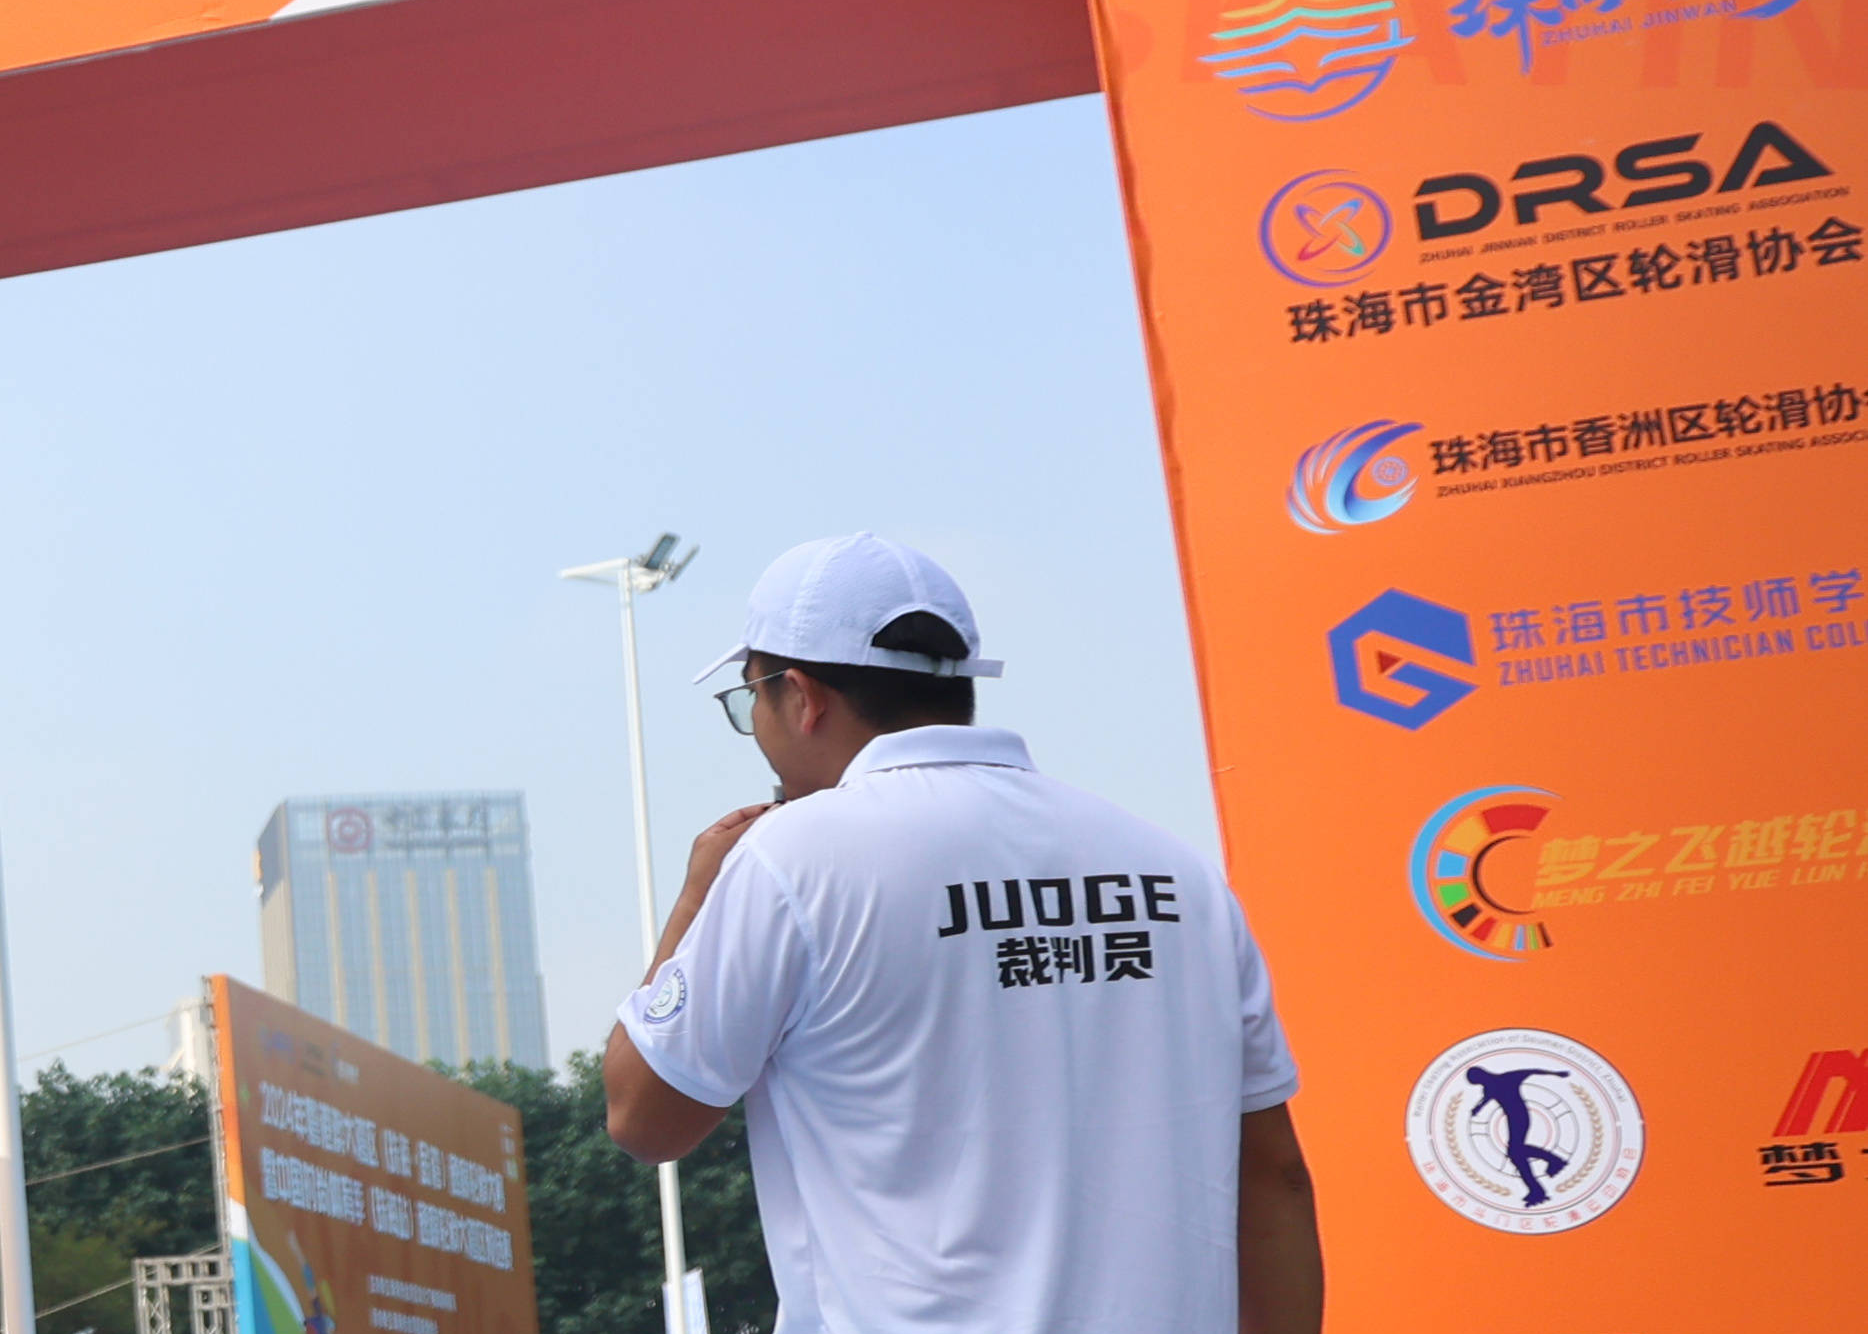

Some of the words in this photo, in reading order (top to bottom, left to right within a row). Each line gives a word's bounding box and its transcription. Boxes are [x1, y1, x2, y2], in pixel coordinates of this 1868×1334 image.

[1539, 17, 1633, 47] ZHUHAI
[1413, 120, 1836, 243] DRSA
[1287, 216, 1865, 346] 珠海市金湾区轮滑协会
[1430, 382, 1868, 476] 珠海市香洲区轮滑协
[1497, 650, 1606, 687] ZHUHAI
[1614, 629, 1794, 672] TECHNICIAN
[1535, 807, 1868, 888] 梦之飞越轮
[938, 873, 1181, 938] JUDGE
[996, 930, 1154, 989] 裁判员
